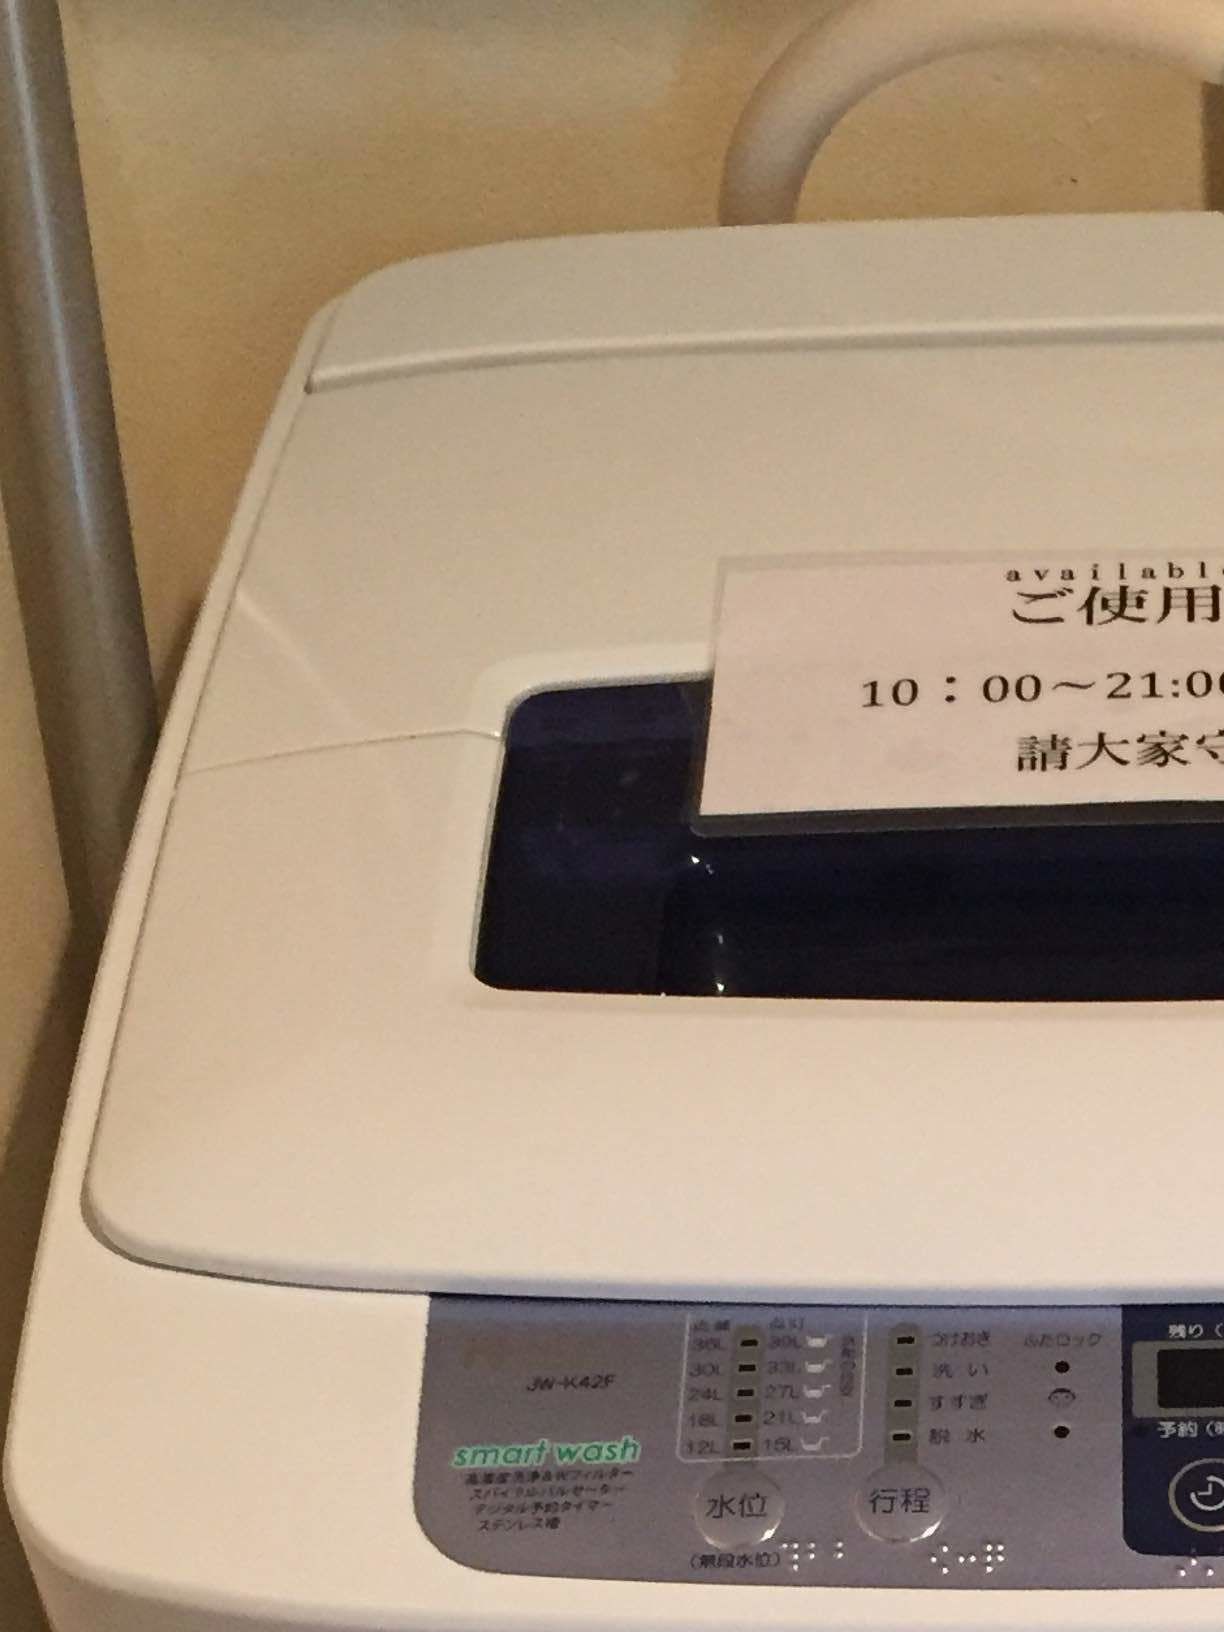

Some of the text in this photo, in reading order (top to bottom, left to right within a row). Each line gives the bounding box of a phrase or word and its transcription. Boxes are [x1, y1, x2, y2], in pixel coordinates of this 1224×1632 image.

[453, 1435, 641, 1468] smart wash
[706, 1494, 769, 1518] 水位
[869, 1488, 931, 1514] 行程
